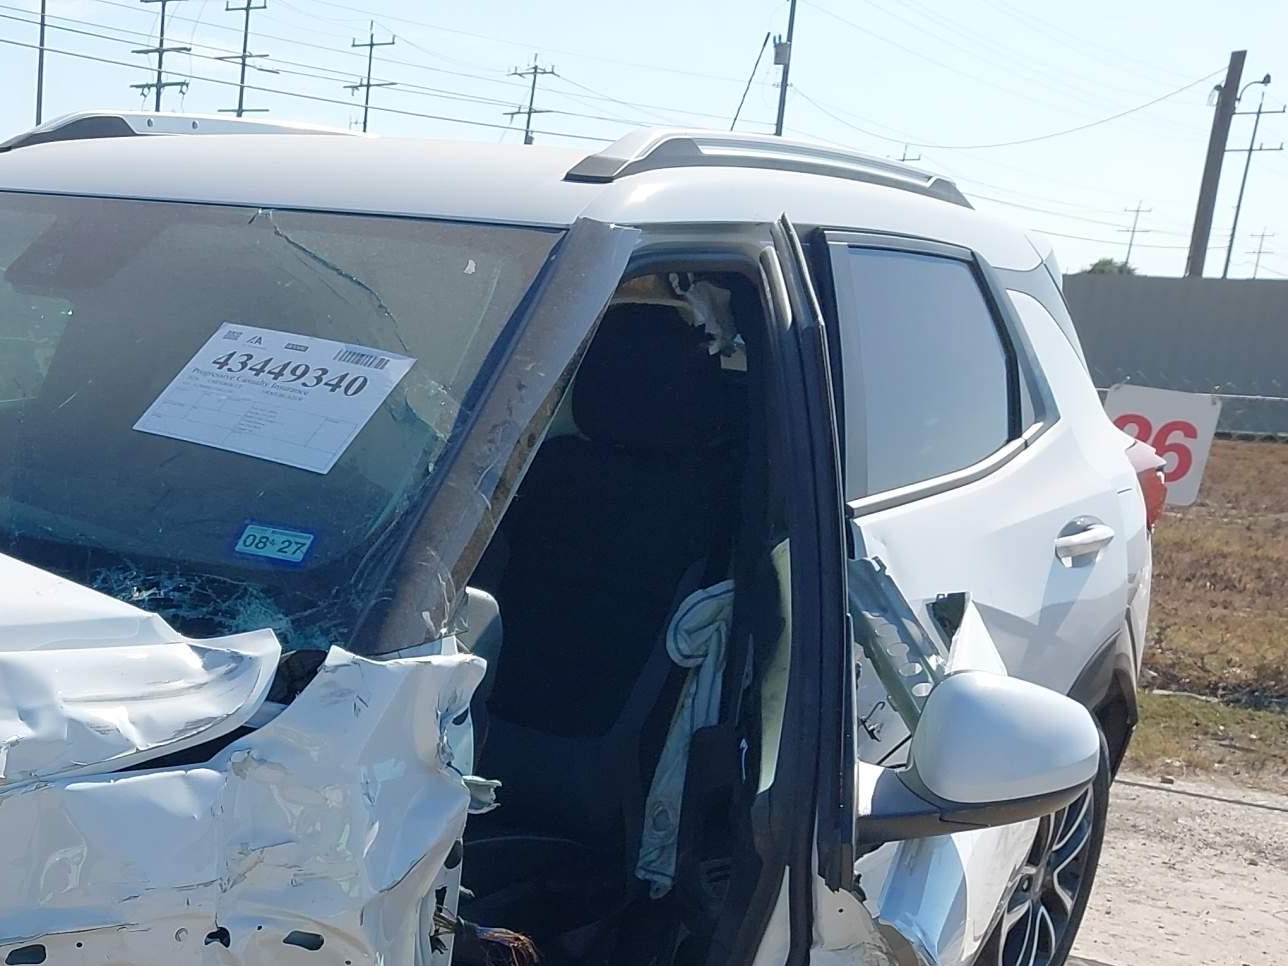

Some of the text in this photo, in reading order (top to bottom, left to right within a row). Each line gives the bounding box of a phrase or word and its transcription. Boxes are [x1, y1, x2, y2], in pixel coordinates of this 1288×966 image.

[212, 350, 368, 397] 43449340
[243, 534, 306, 555] 08 27
